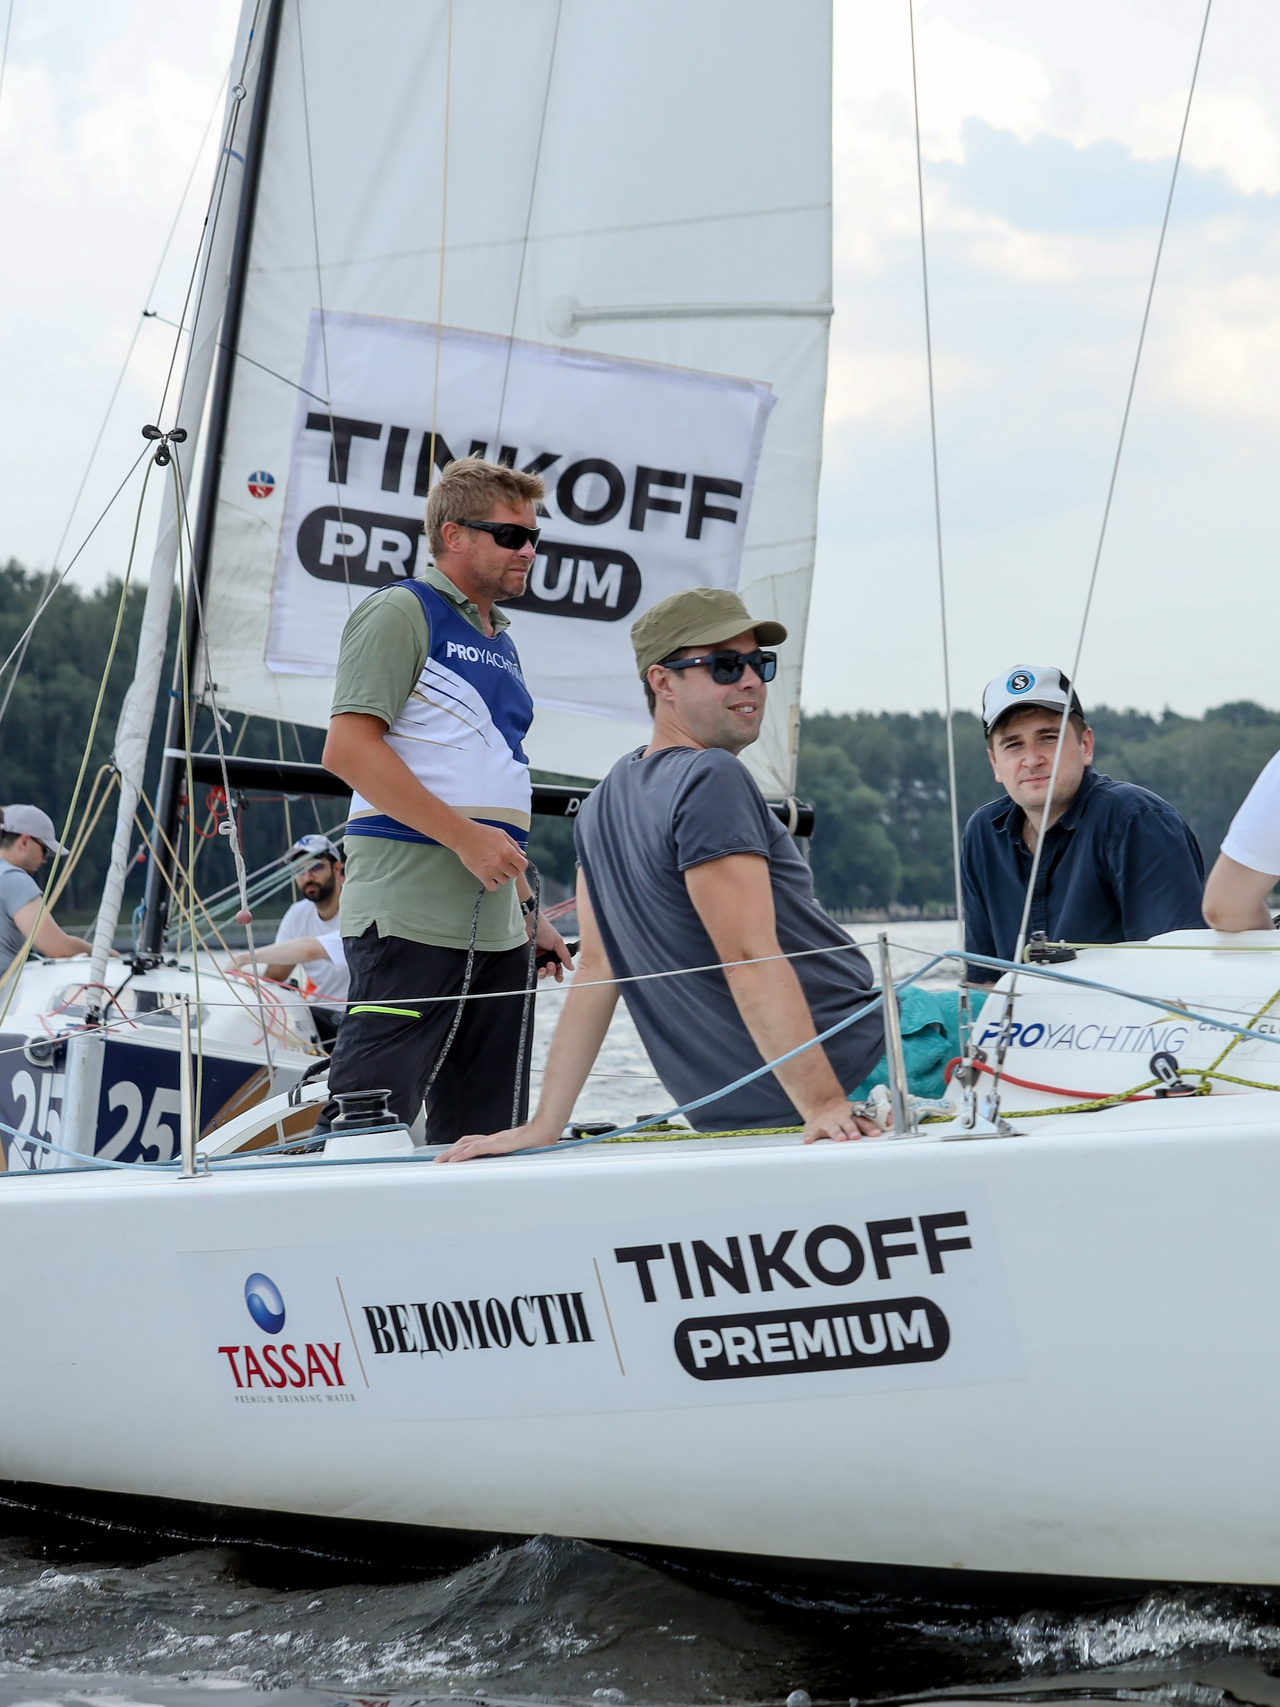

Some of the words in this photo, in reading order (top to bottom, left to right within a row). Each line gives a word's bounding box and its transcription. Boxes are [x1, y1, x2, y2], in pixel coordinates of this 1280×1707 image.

[319, 518, 623, 609] PRUM
[978, 1022, 1189, 1053] PROYACHTING
[8, 1070, 66, 1172] 25
[94, 1080, 182, 1164] 25
[614, 1210, 973, 1303] TINKOFF
[362, 1291, 595, 1360] ВЕДОМОСТИ
[687, 1309, 935, 1369] PREMIUM
[218, 1342, 346, 1388] TASSAY
[234, 1395, 274, 1403] PREMIUM
[277, 1394, 323, 1403] DRINKING
[326, 1393, 356, 1402] WATER
